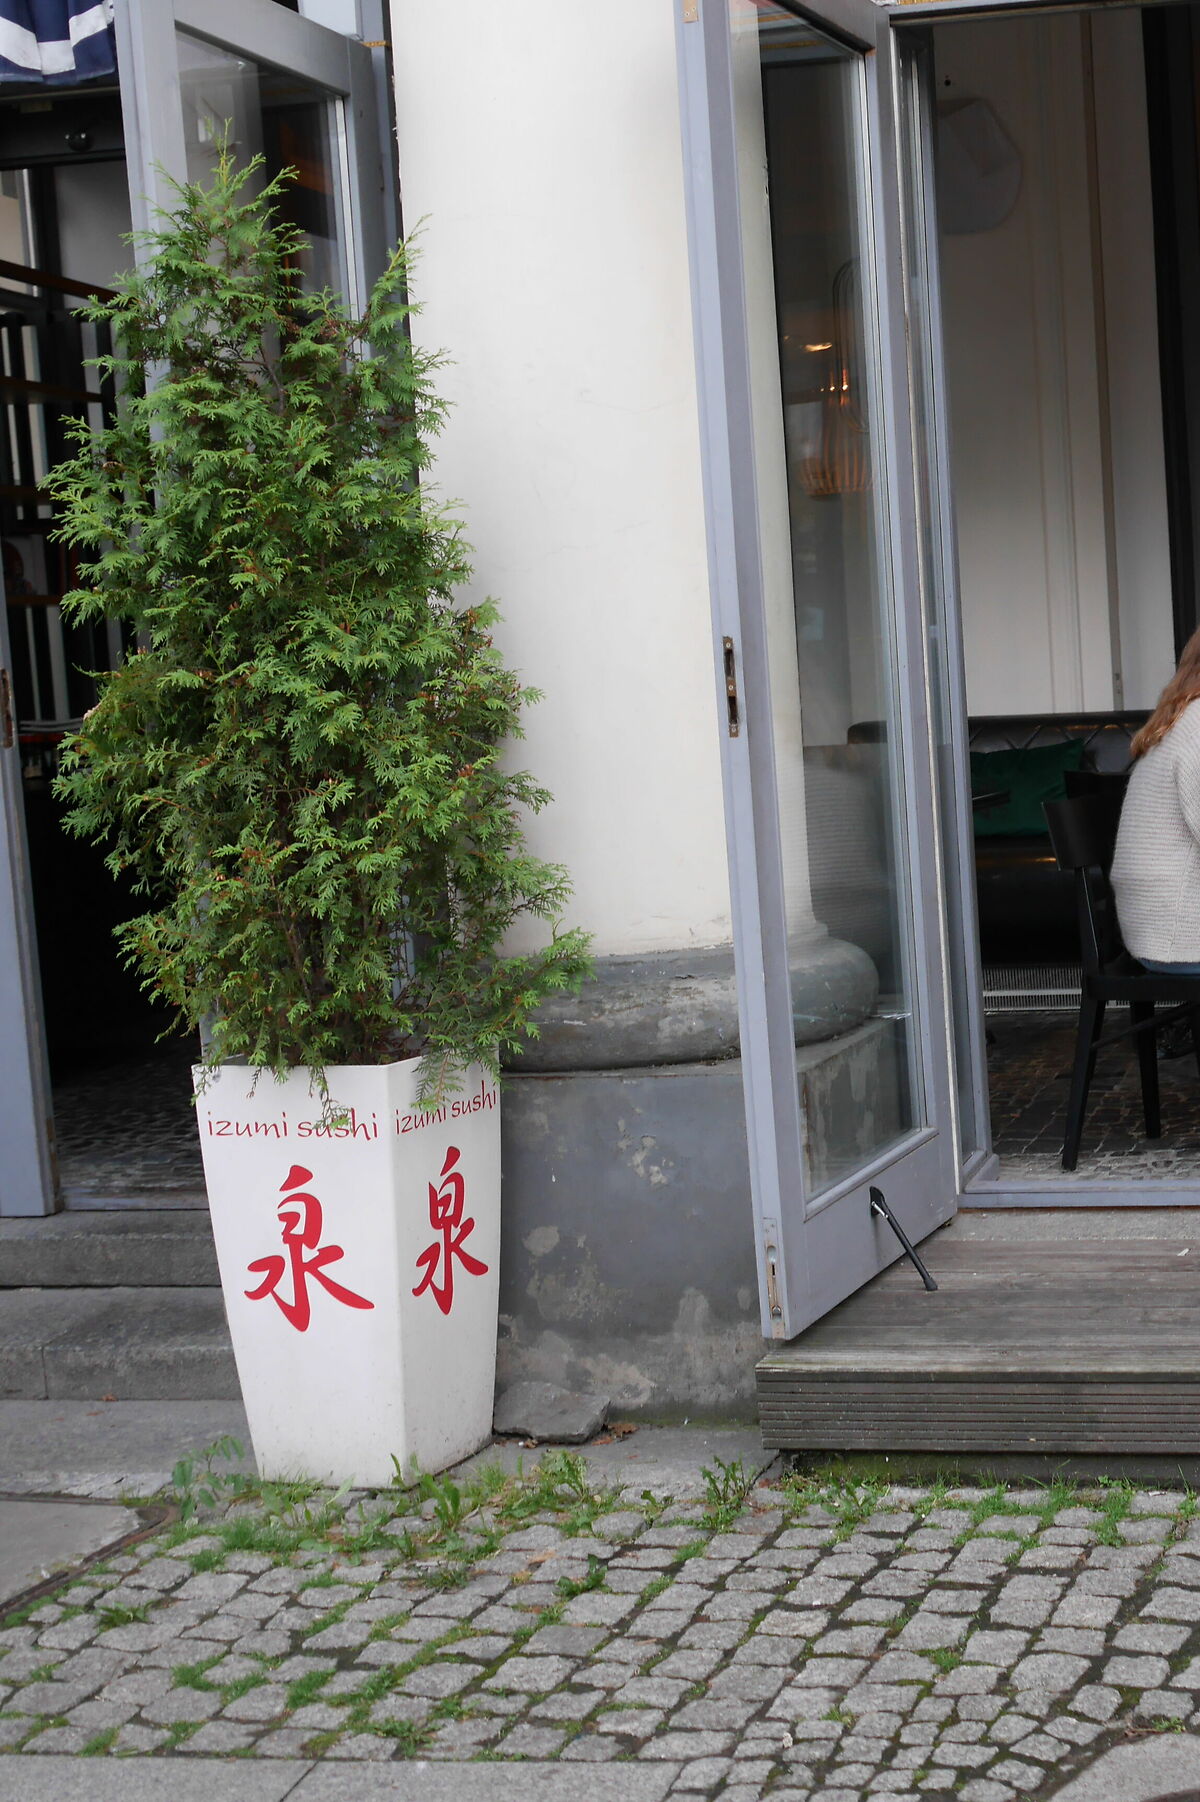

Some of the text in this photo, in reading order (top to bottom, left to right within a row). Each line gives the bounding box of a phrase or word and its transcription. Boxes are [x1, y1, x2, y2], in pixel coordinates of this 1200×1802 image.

[207, 1107, 379, 1141] izumi sushi
[395, 1080, 498, 1135] izumi sushi
